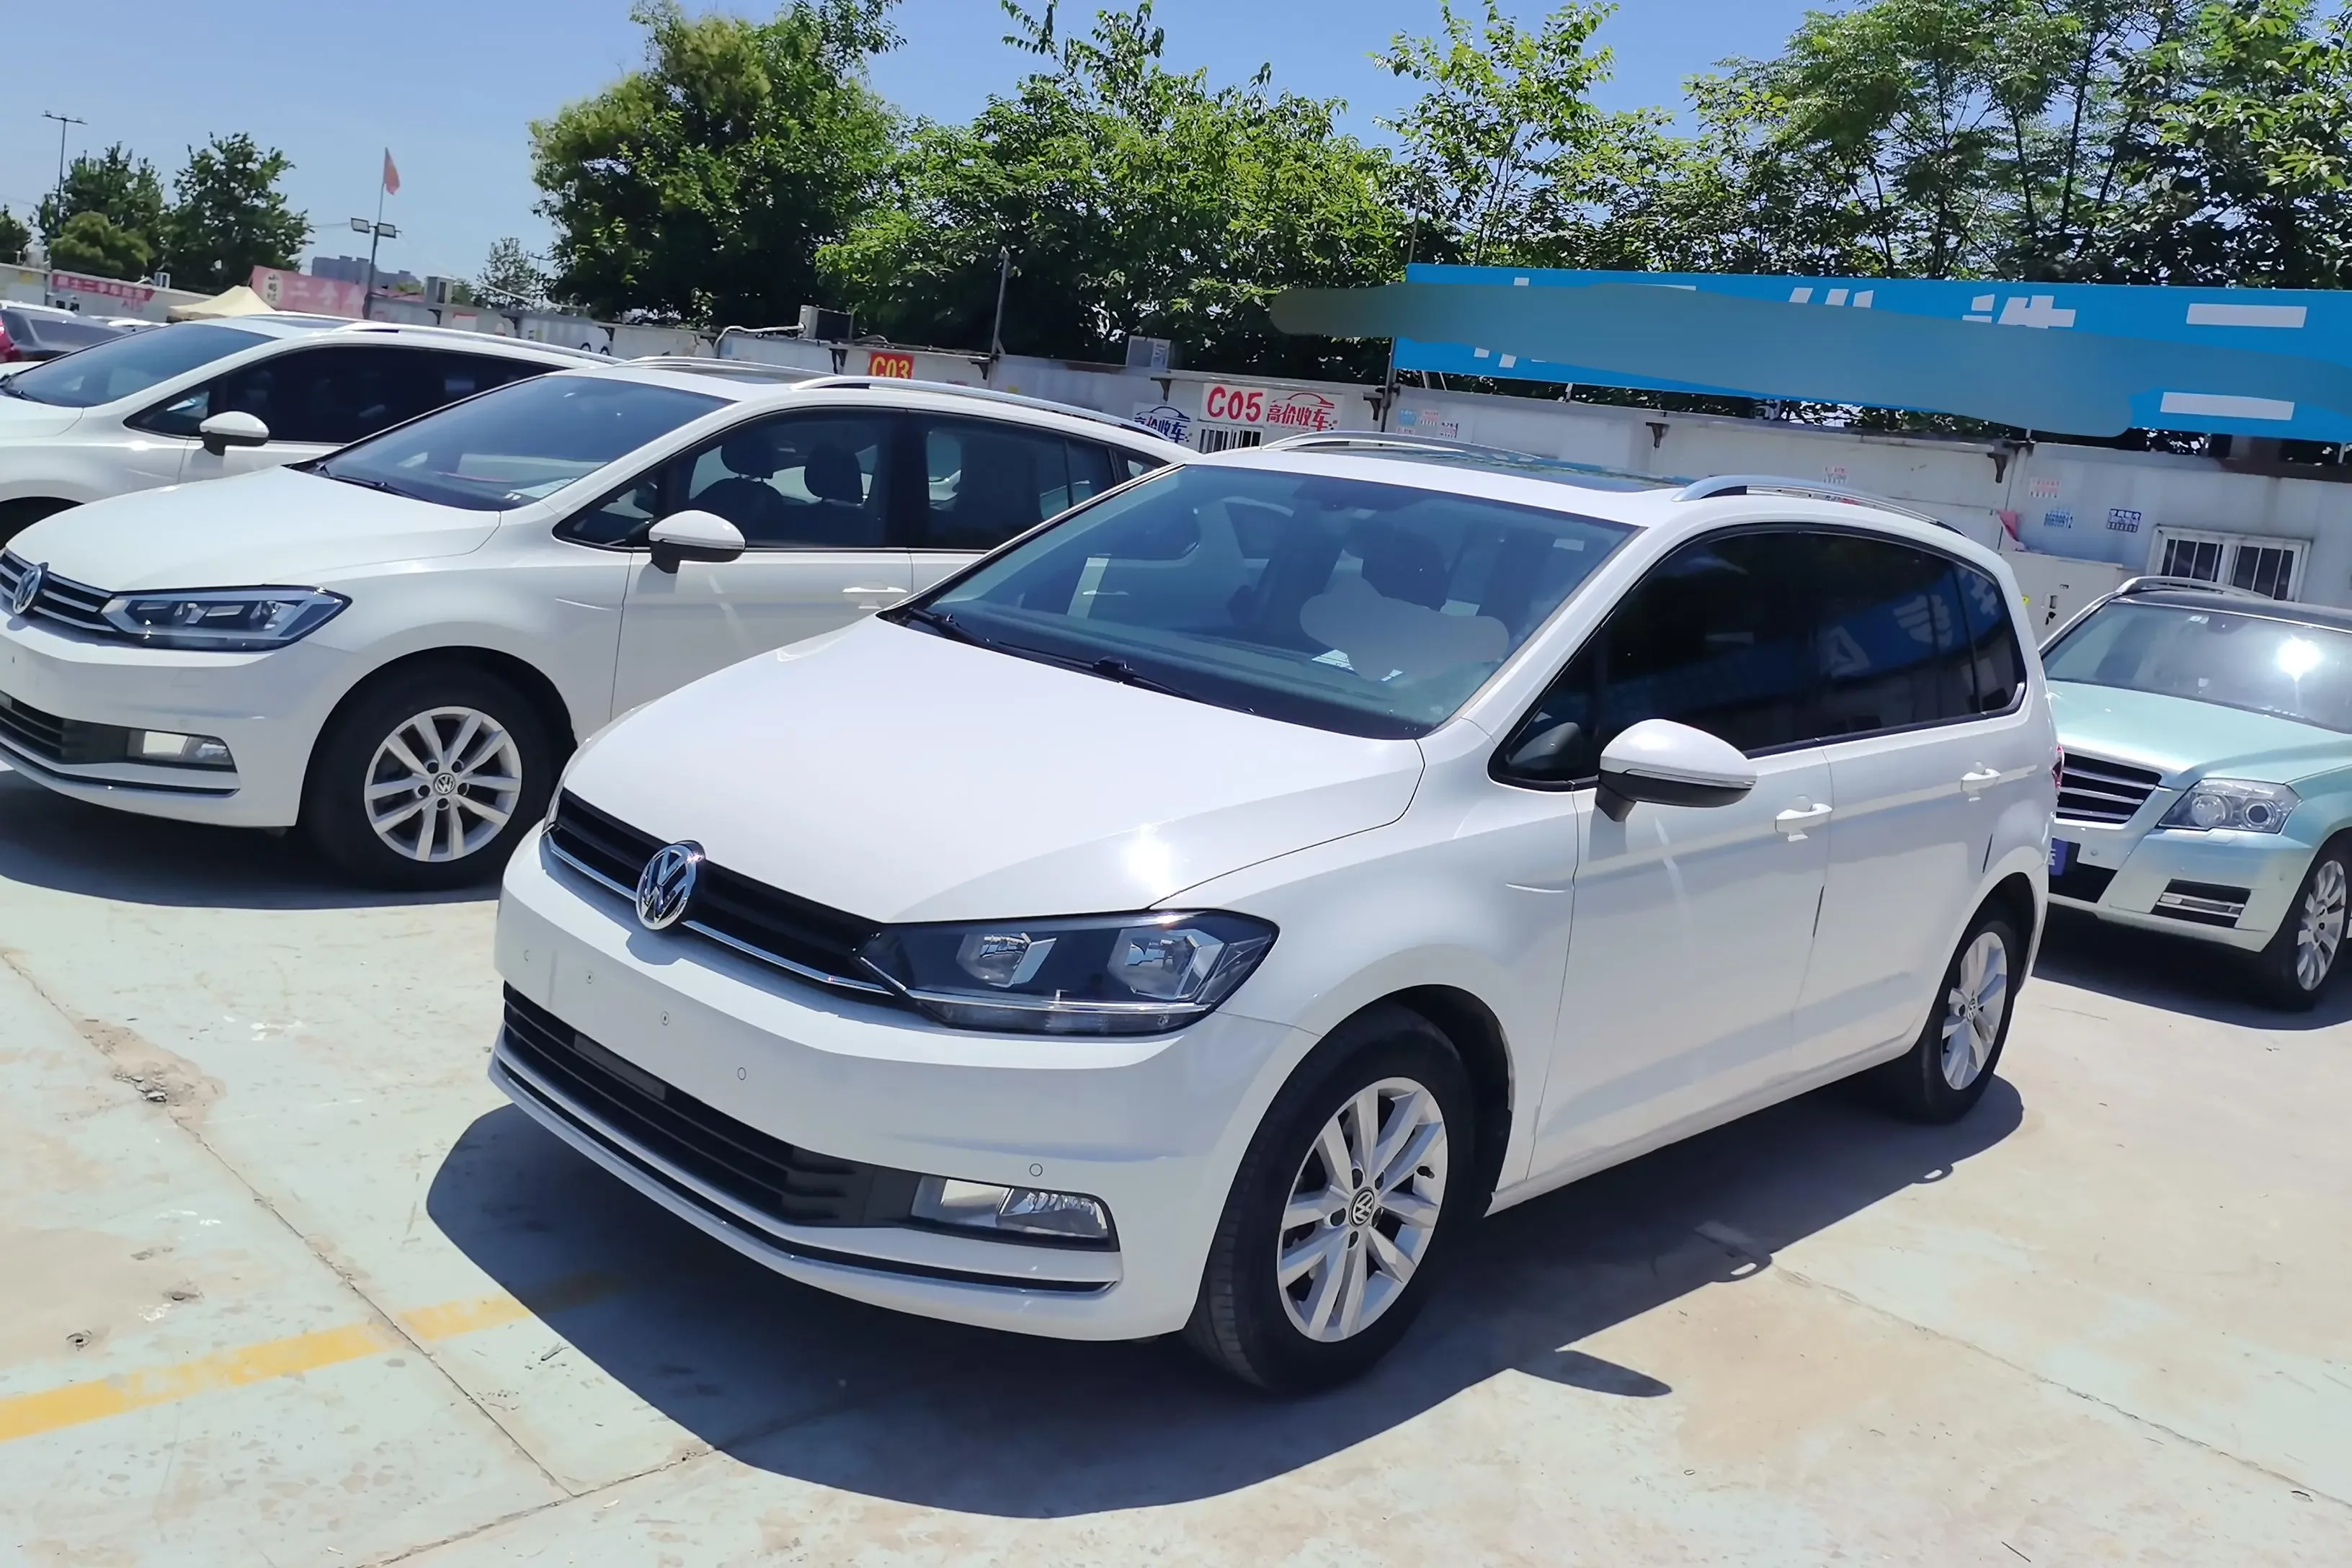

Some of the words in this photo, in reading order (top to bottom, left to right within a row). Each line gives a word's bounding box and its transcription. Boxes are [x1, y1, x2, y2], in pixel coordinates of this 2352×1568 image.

[872, 356, 909, 379] C03
[1207, 386, 1263, 422] C05
[1266, 403, 1331, 432] 高价收车
